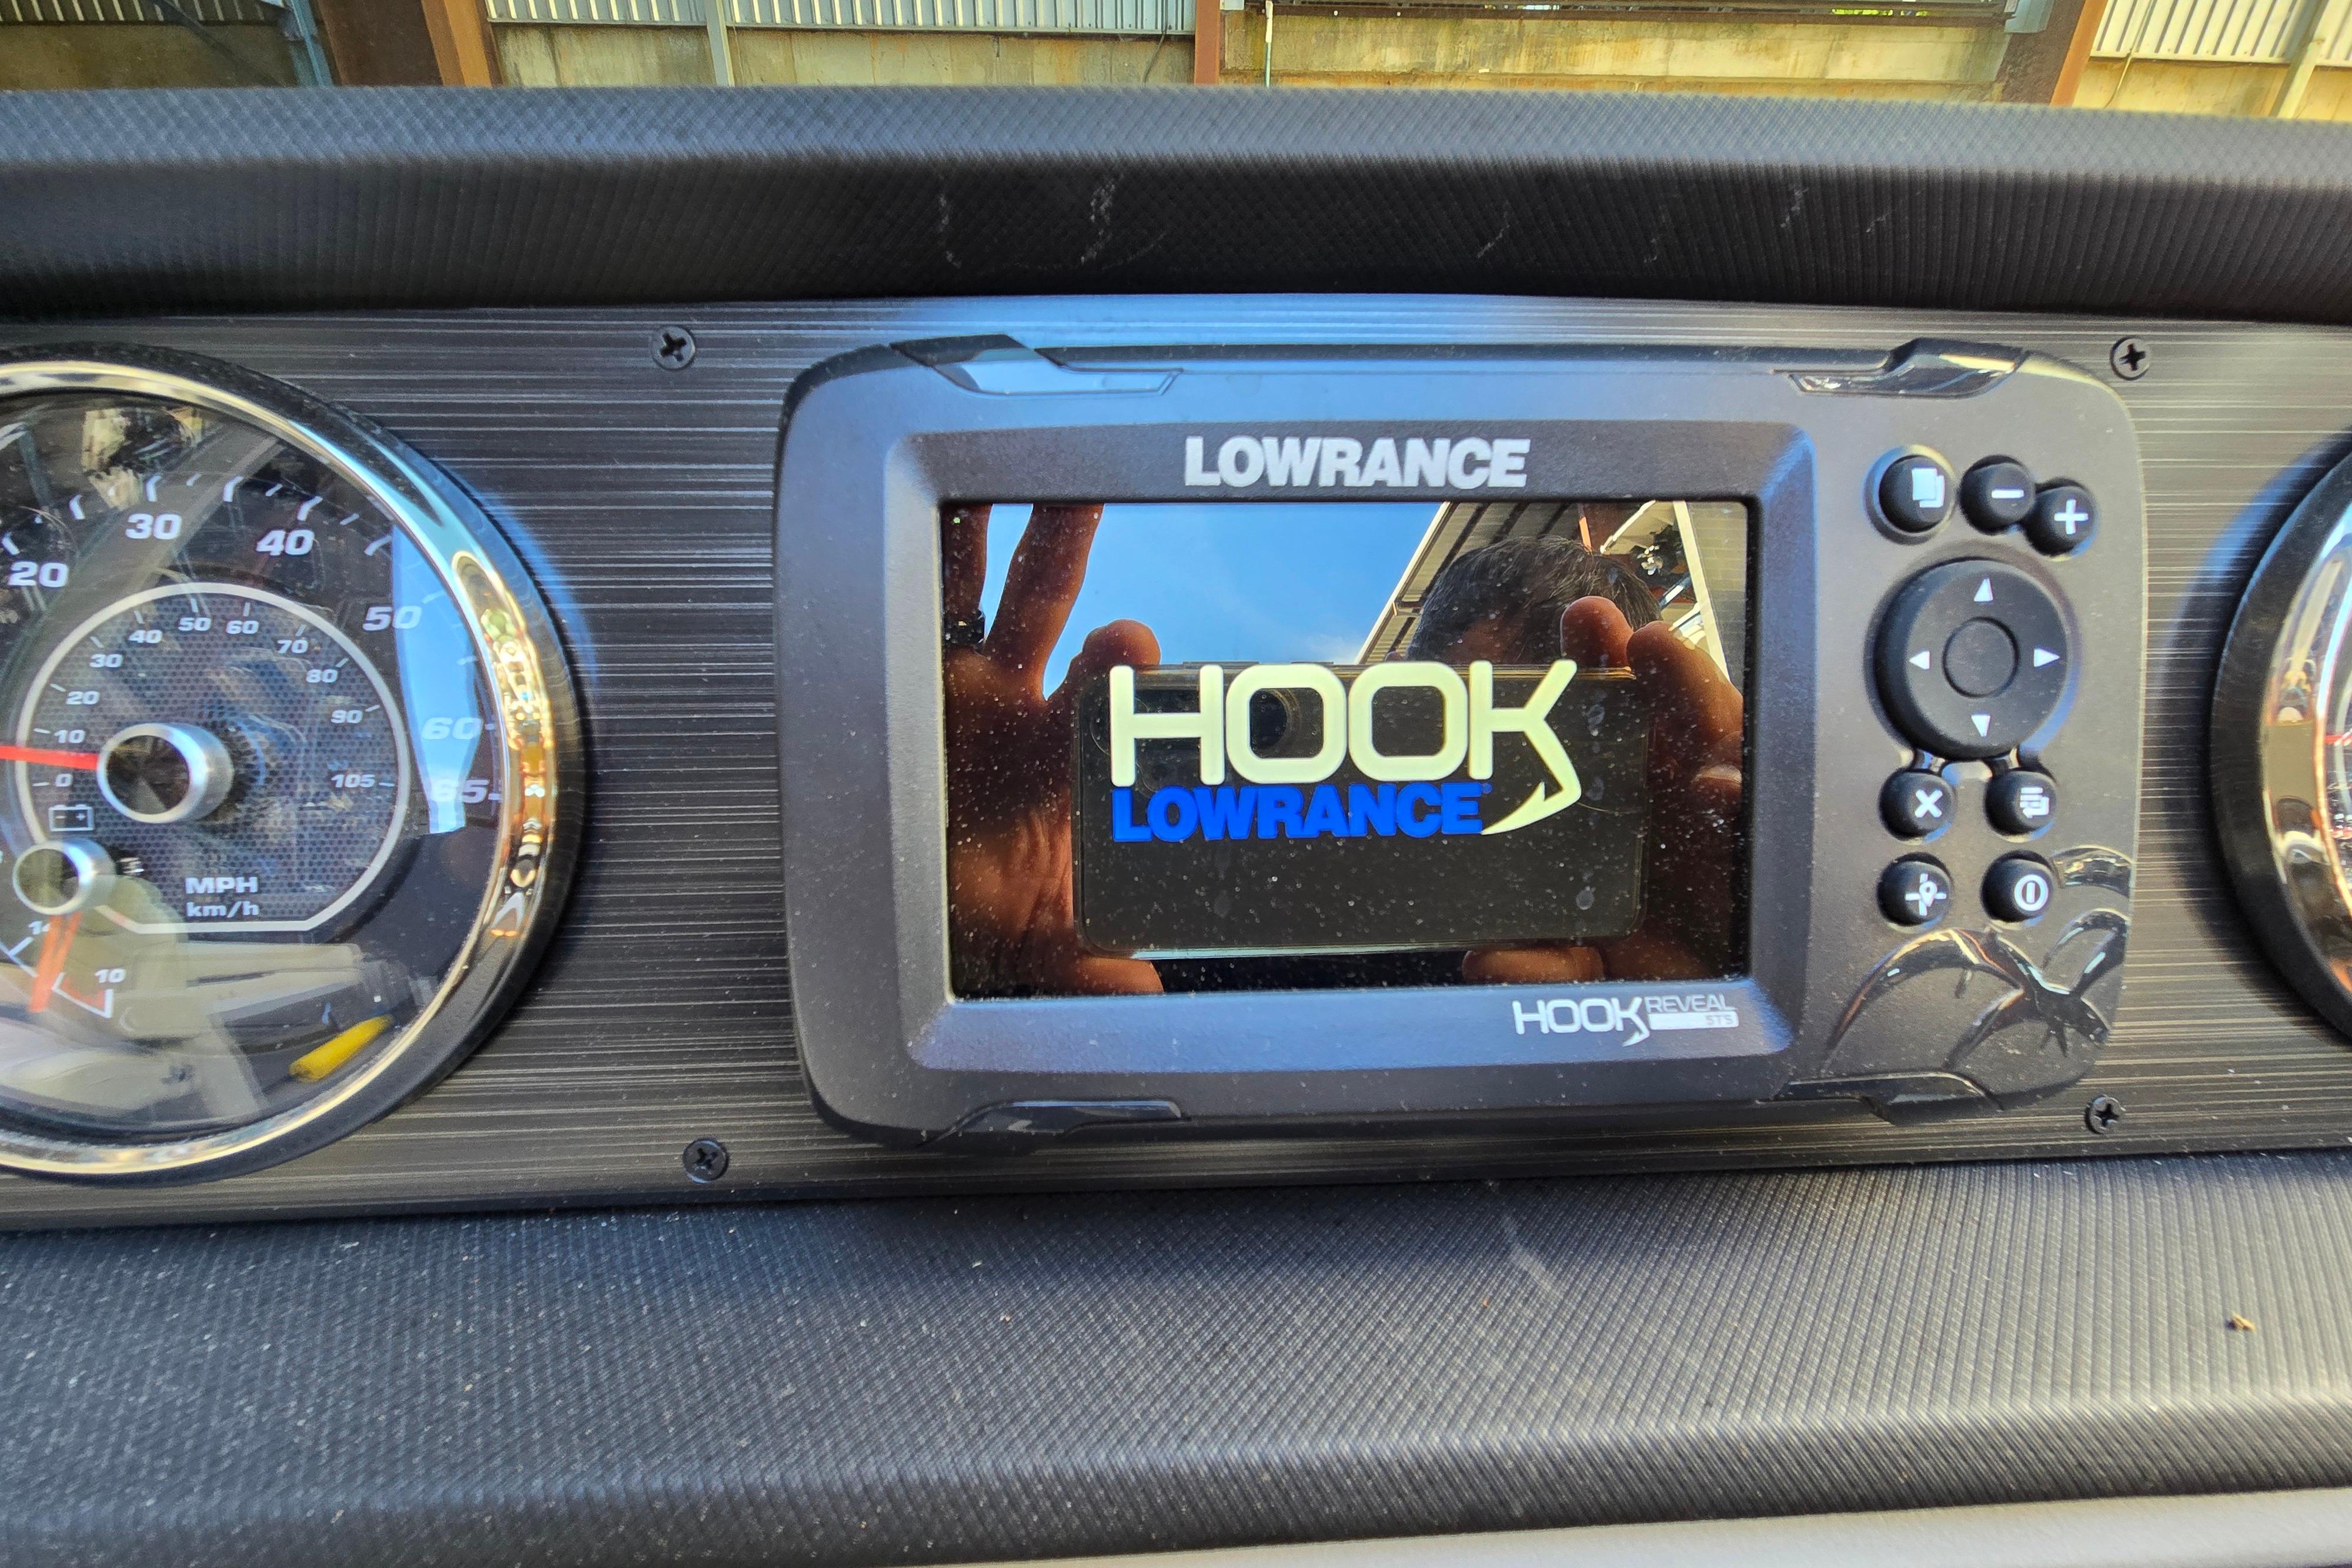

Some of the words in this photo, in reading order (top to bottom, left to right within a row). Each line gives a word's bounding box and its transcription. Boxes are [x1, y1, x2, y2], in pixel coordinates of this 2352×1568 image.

[1184, 436, 1531, 489] LOWRANCE
[126, 513, 182, 539] 30
[256, 530, 315, 556] 40
[8, 561, 69, 587] 20
[178, 617, 211, 631] 50
[362, 606, 422, 630] 50
[226, 620, 259, 634] 60
[128, 630, 162, 644] 40
[277, 639, 308, 654] 70
[89, 653, 122, 668] 30
[306, 669, 338, 683] 80
[65, 691, 99, 705] 20
[330, 710, 363, 724] 90
[422, 717, 482, 740] 60
[54, 730, 85, 743] 10
[1109, 660, 1582, 834] HOOK
[55, 773, 73, 787] 0
[330, 774, 376, 788] 105
[1111, 783, 1483, 842] LOWRANCE
[185, 877, 258, 894] MPH
[186, 901, 259, 918] km/h
[95, 968, 126, 983] 10
[1512, 997, 1650, 1047] HOOK
[1645, 994, 1738, 1012] REVEAL
